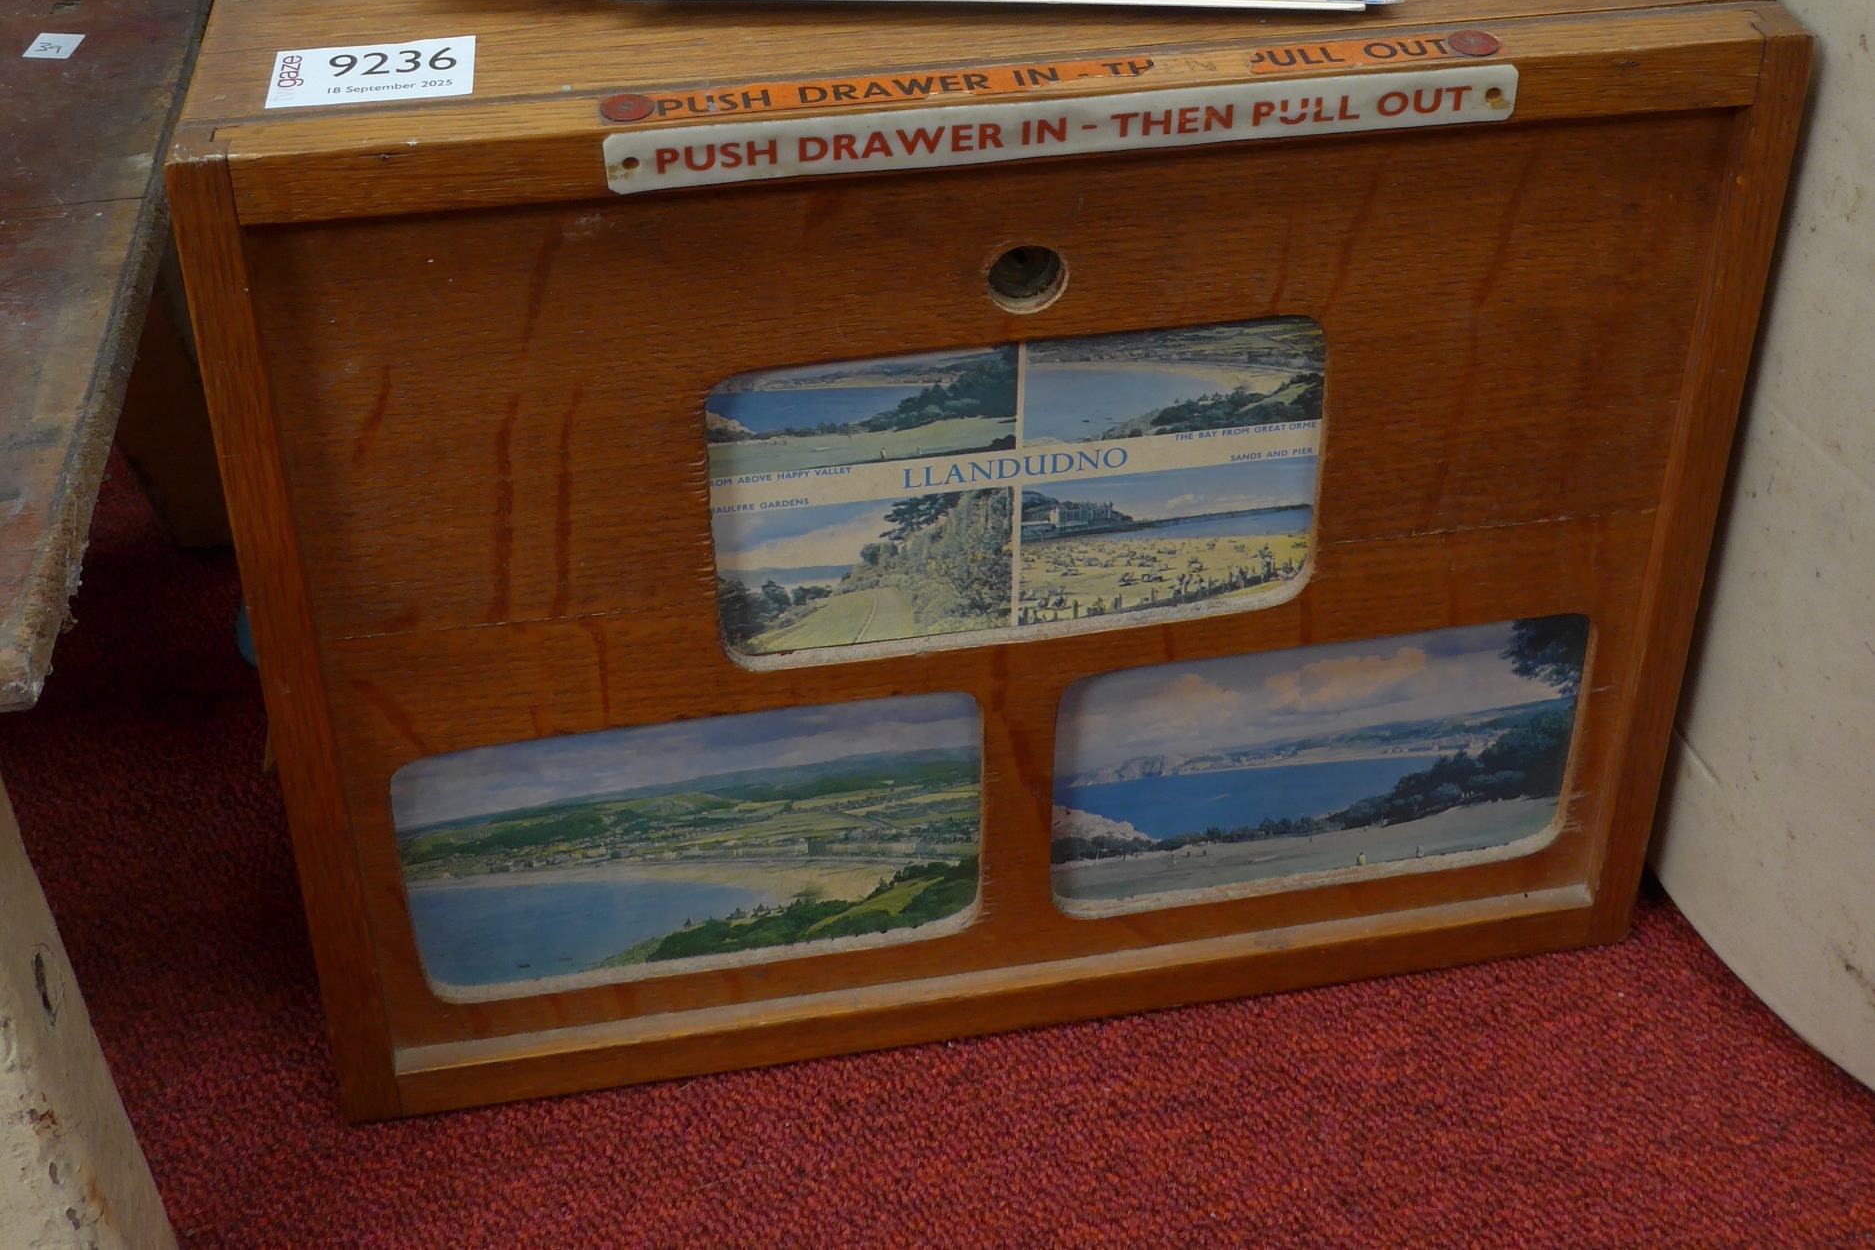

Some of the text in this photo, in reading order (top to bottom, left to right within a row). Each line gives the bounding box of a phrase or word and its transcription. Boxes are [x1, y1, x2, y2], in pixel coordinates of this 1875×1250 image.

[328, 46, 458, 77] 9236
[327, 79, 453, 94] 18 September 2025
[656, 88, 772, 117] PUSH
[798, 72, 990, 105] DRAWER
[1012, 67, 1059, 87] IN
[1363, 38, 1448, 61] OUT
[655, 139, 778, 174] PUSH
[798, 122, 1005, 163] DRAWER
[1021, 116, 1067, 146] IN
[1110, 103, 1234, 138] THEN
[1252, 94, 1361, 127] PULL
[1376, 85, 1473, 117] OUT
[1174, 420, 1317, 441] THE BAY FROM GREAT ORME
[1230, 446, 1313, 462] SANDS AND PIER
[708, 466, 852, 487] ROM ABOVE HAPPY VALLEY
[902, 447, 1128, 489] LLANDUDNO
[759, 497, 809, 509] GARDENS
